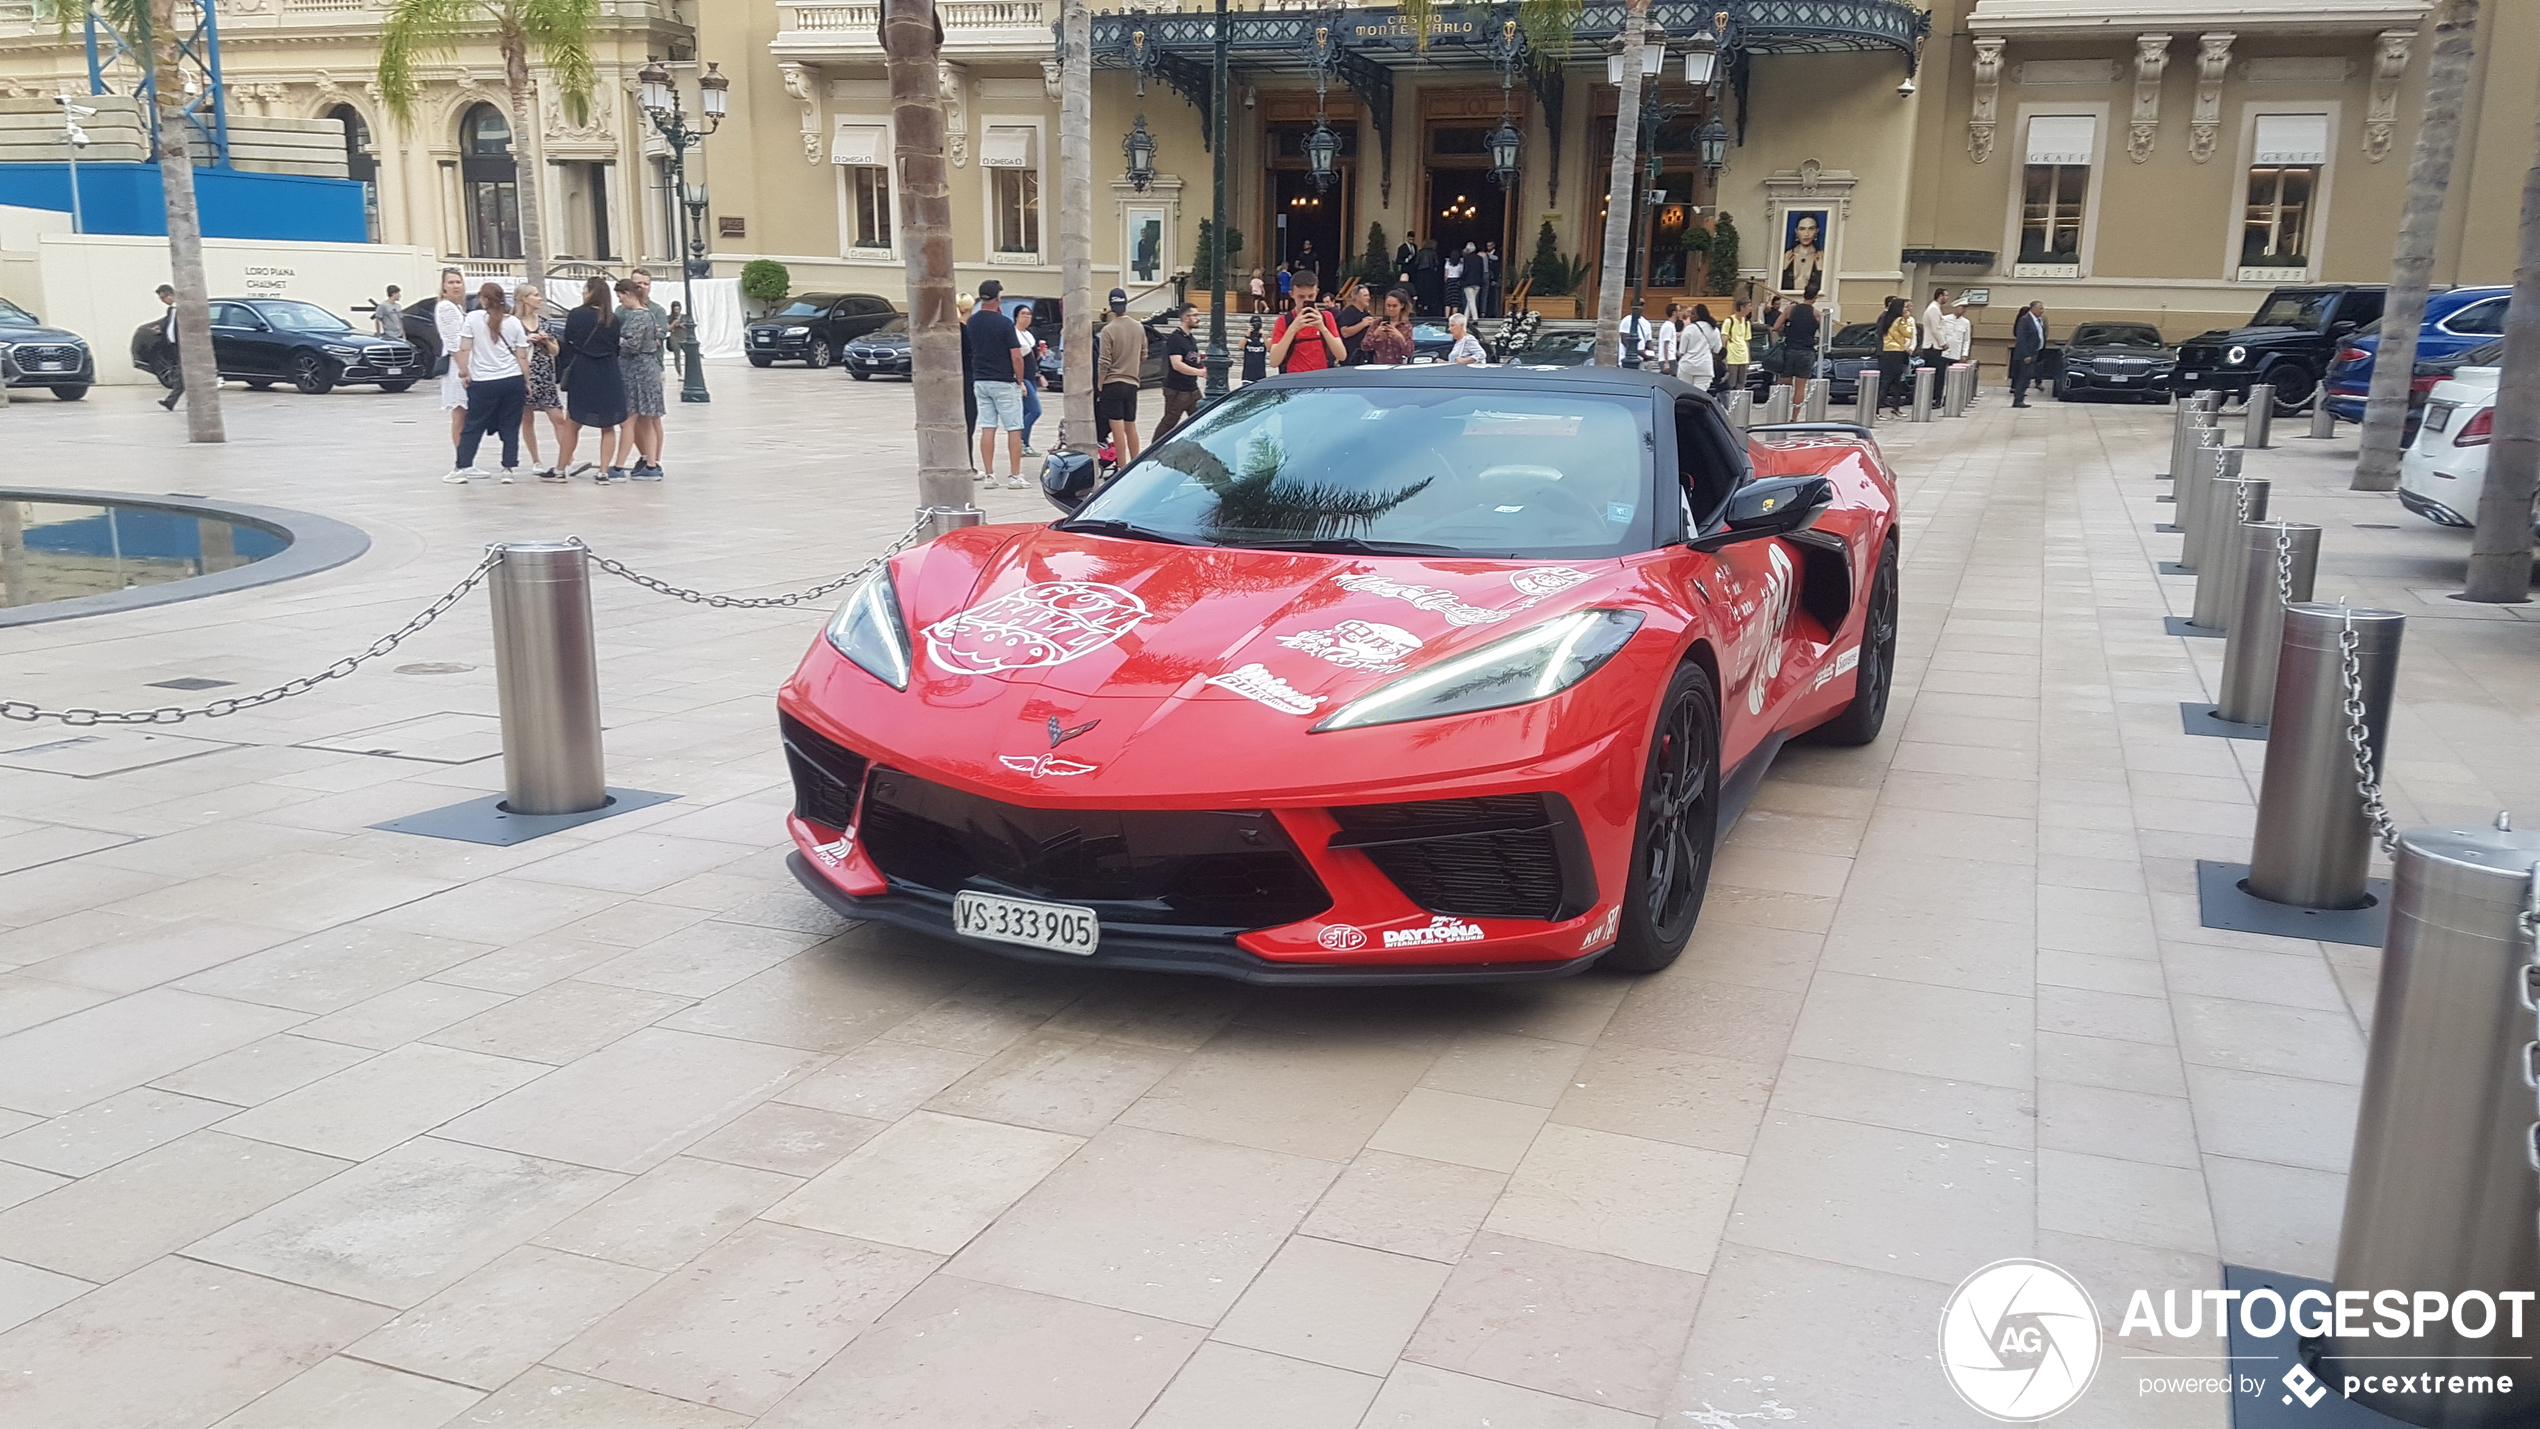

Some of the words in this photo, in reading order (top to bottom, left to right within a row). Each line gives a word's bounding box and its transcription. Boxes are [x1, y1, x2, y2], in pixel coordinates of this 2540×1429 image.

[1387, 14, 1442, 25] CASNO
[2029, 152, 2087, 163] GRAFF
[2260, 152, 2320, 162] GRAFF
[245, 267, 269, 276] LORO
[270, 267, 295, 276] PIANA
[2018, 267, 2074, 276] GRAFF
[2243, 270, 2302, 279] GRAFF
[1323, 927, 1362, 948] STP
[1383, 924, 1484, 943] DAYTONA
[1385, 938, 1443, 949] INTERNATIONAL
[1446, 934, 1485, 943] SPEEDWAY
